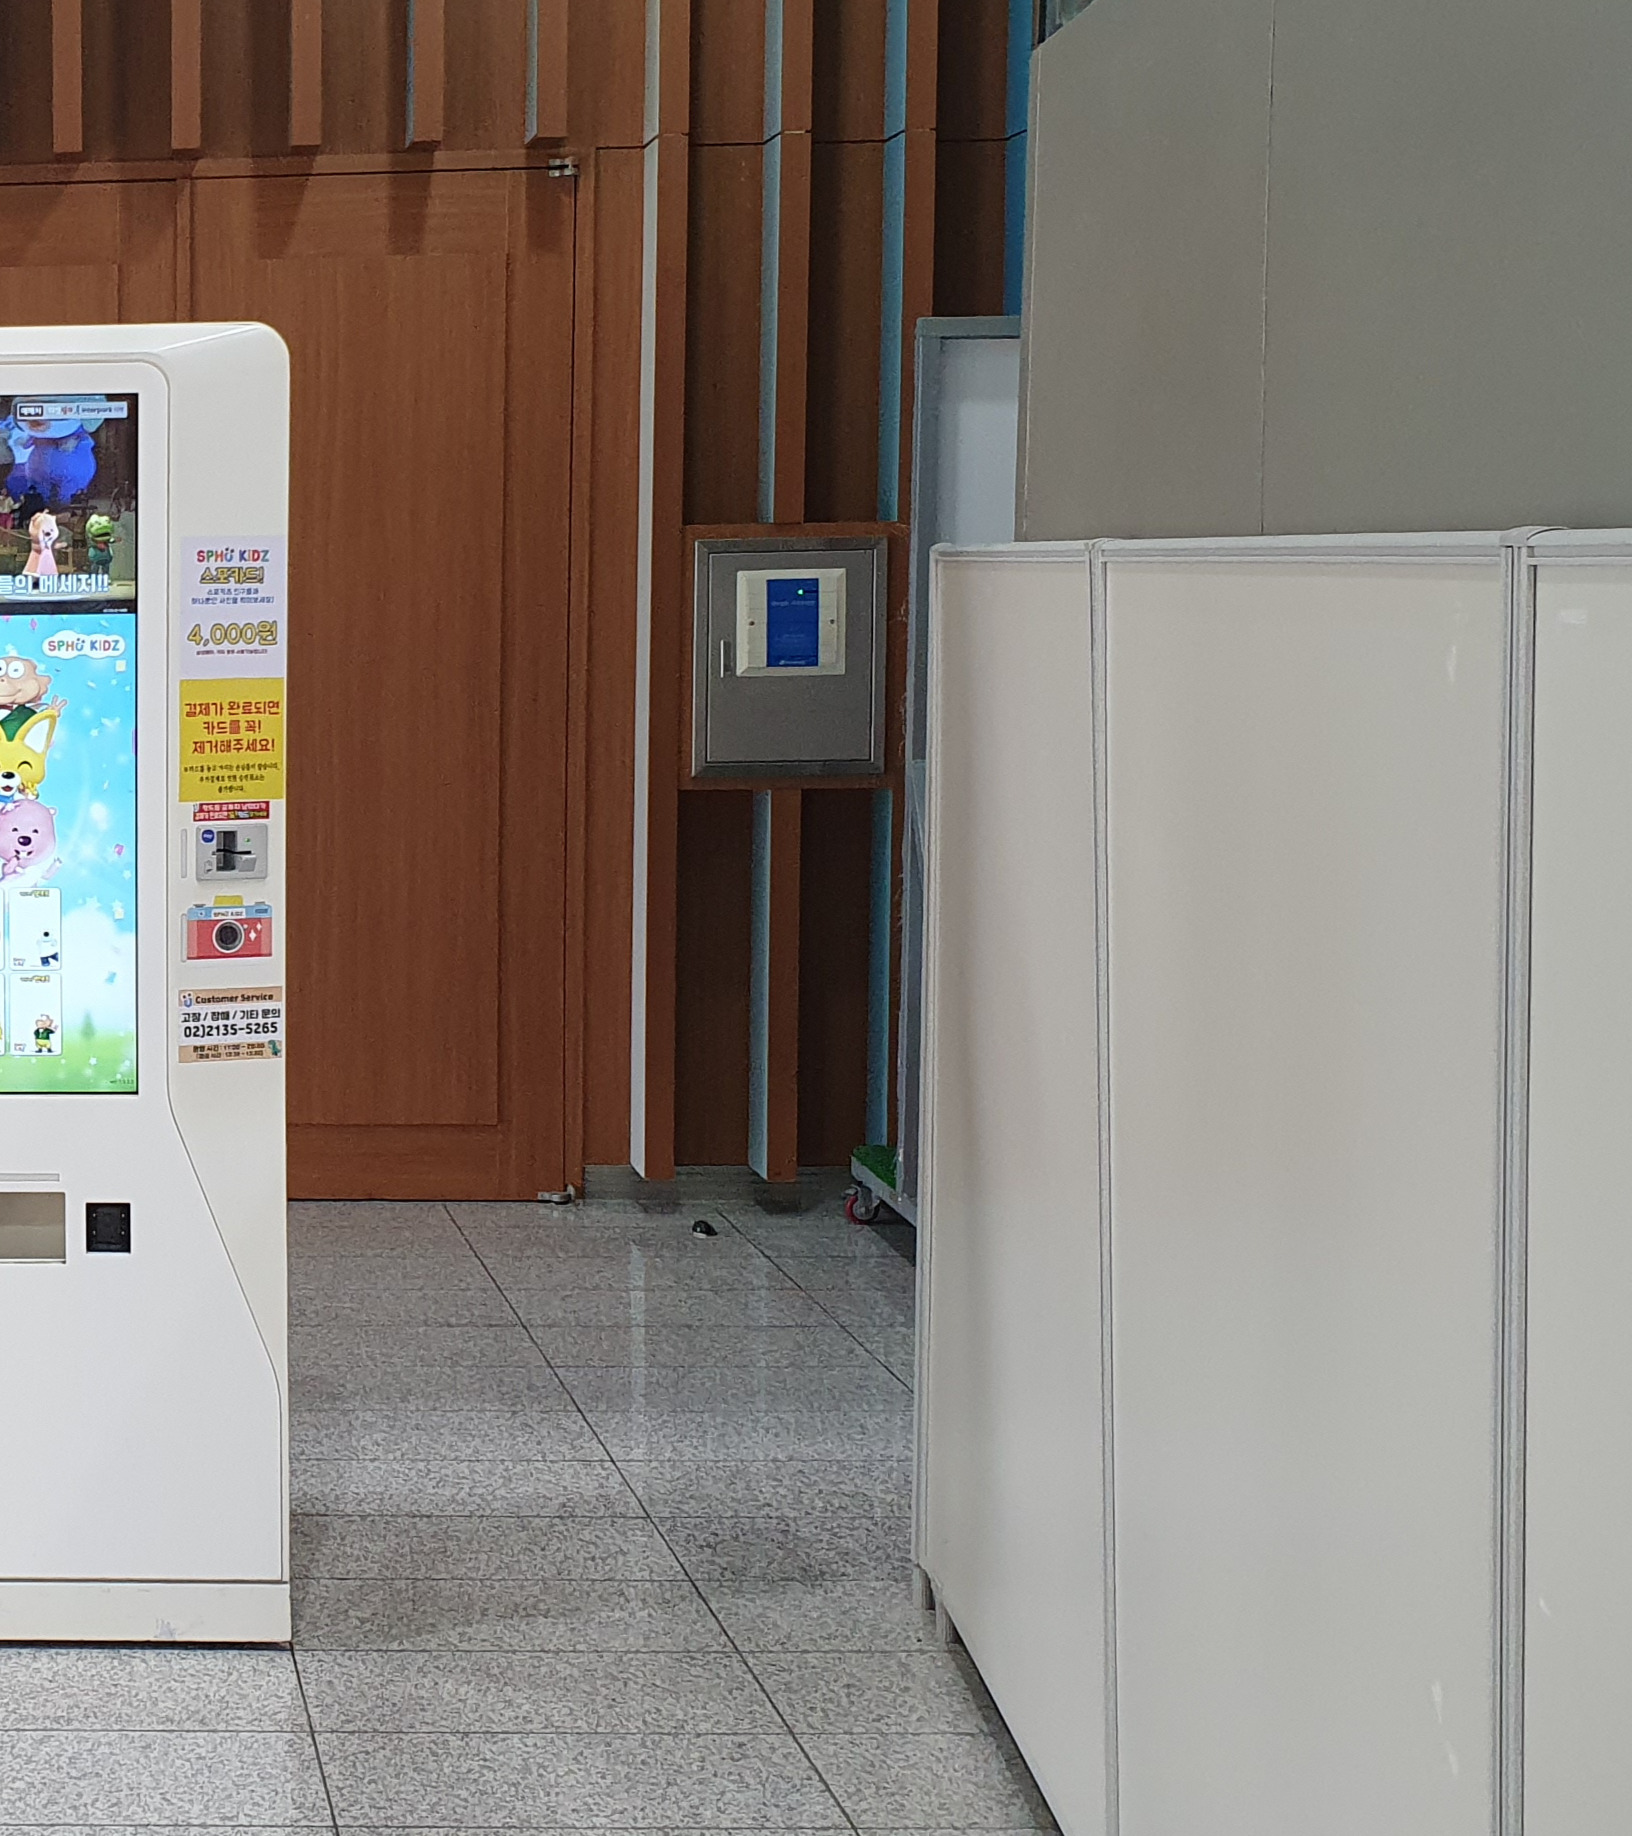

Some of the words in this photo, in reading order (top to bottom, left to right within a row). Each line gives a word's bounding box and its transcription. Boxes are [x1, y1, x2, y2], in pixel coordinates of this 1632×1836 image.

[239, 549, 270, 562] KIDZ
[187, 620, 278, 647] 4,000원
[90, 639, 120, 652] KIDZ
[184, 701, 224, 718] 결제가
[227, 700, 280, 716] 완료되면
[203, 720, 241, 735] 카드를
[244, 719, 262, 734] 꼭!
[192, 738, 276, 755] 제거해주세요!
[195, 994, 239, 1004] Customer
[240, 992, 274, 1002] Service
[181, 1012, 201, 1023] 고장
[239, 1009, 259, 1020] 기타
[262, 1008, 280, 1019] 문의
[184, 1021, 278, 1038] 02)2135-5265
